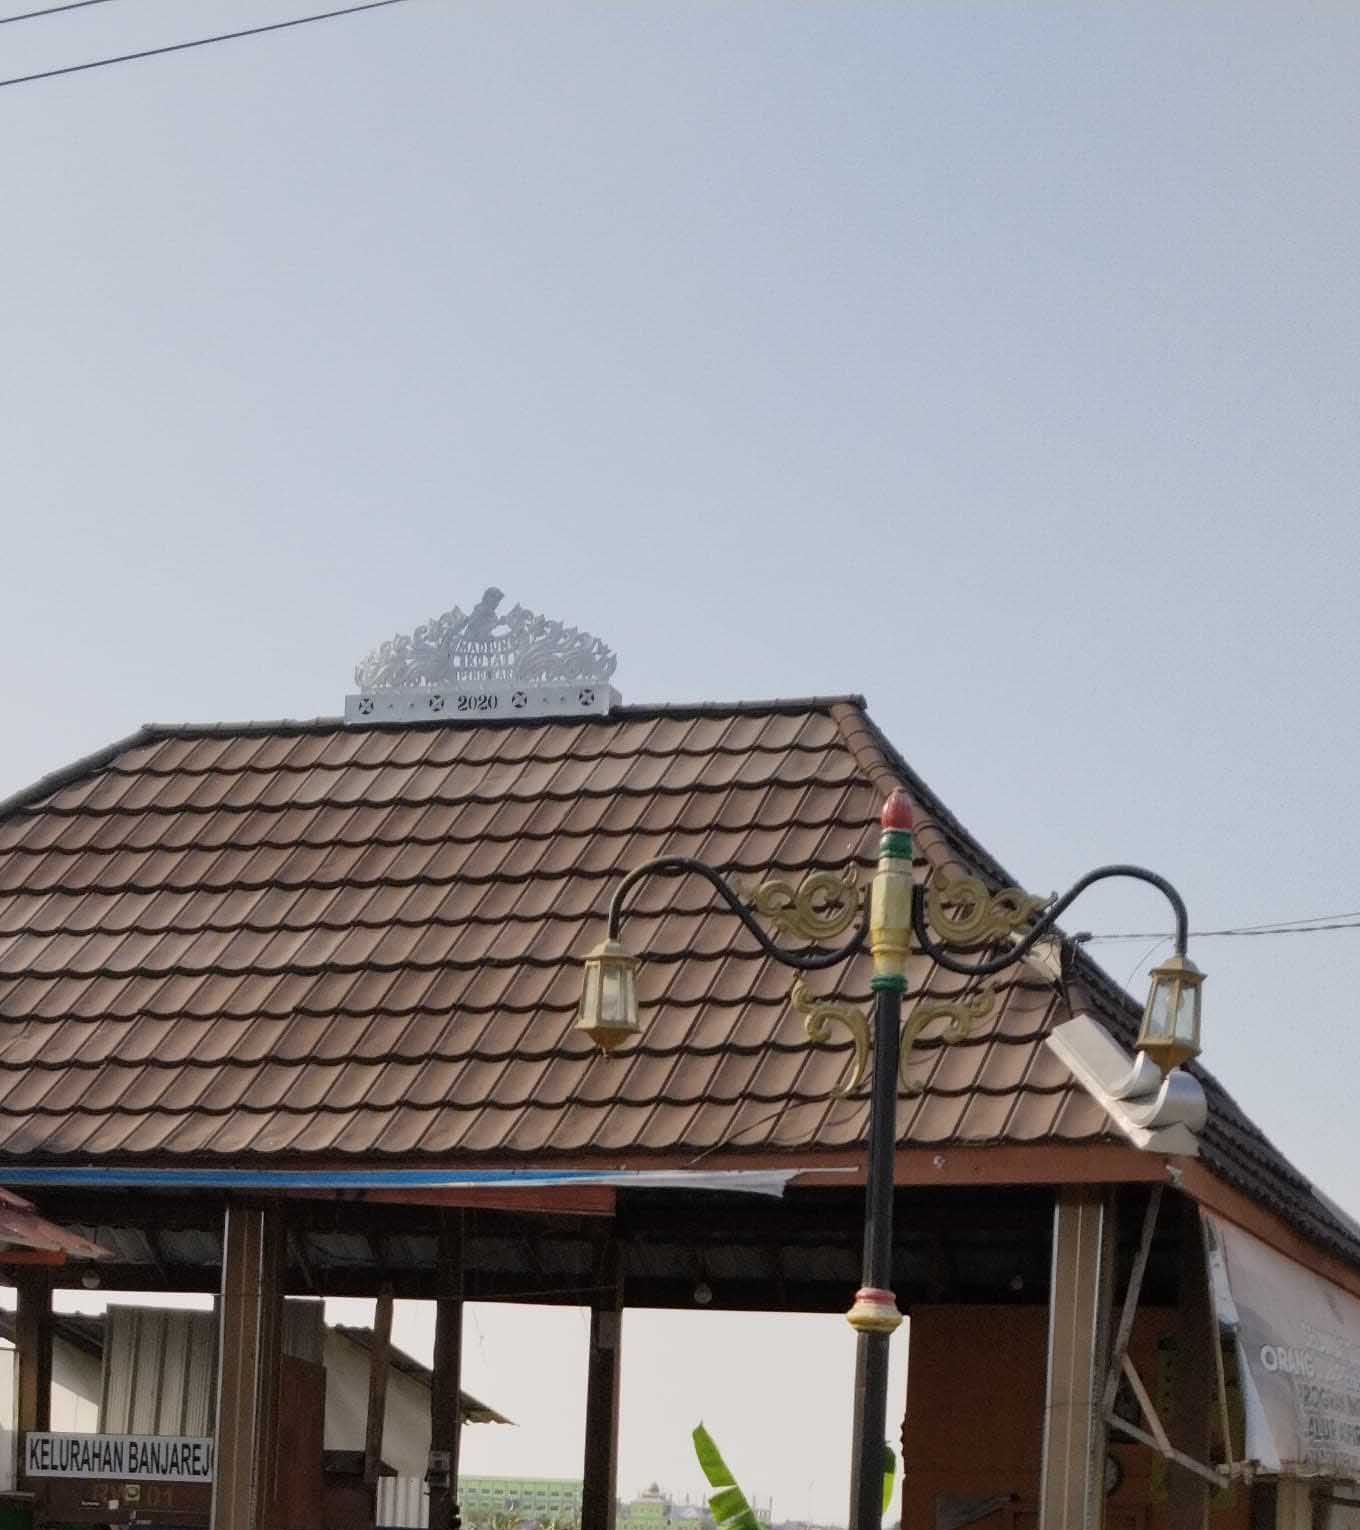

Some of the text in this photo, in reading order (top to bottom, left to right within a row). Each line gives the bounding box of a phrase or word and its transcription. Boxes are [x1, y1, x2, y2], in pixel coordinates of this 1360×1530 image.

[457, 695, 498, 711] 2020
[29, 1438, 214, 1476] KELURAHAN BANJAREJ
